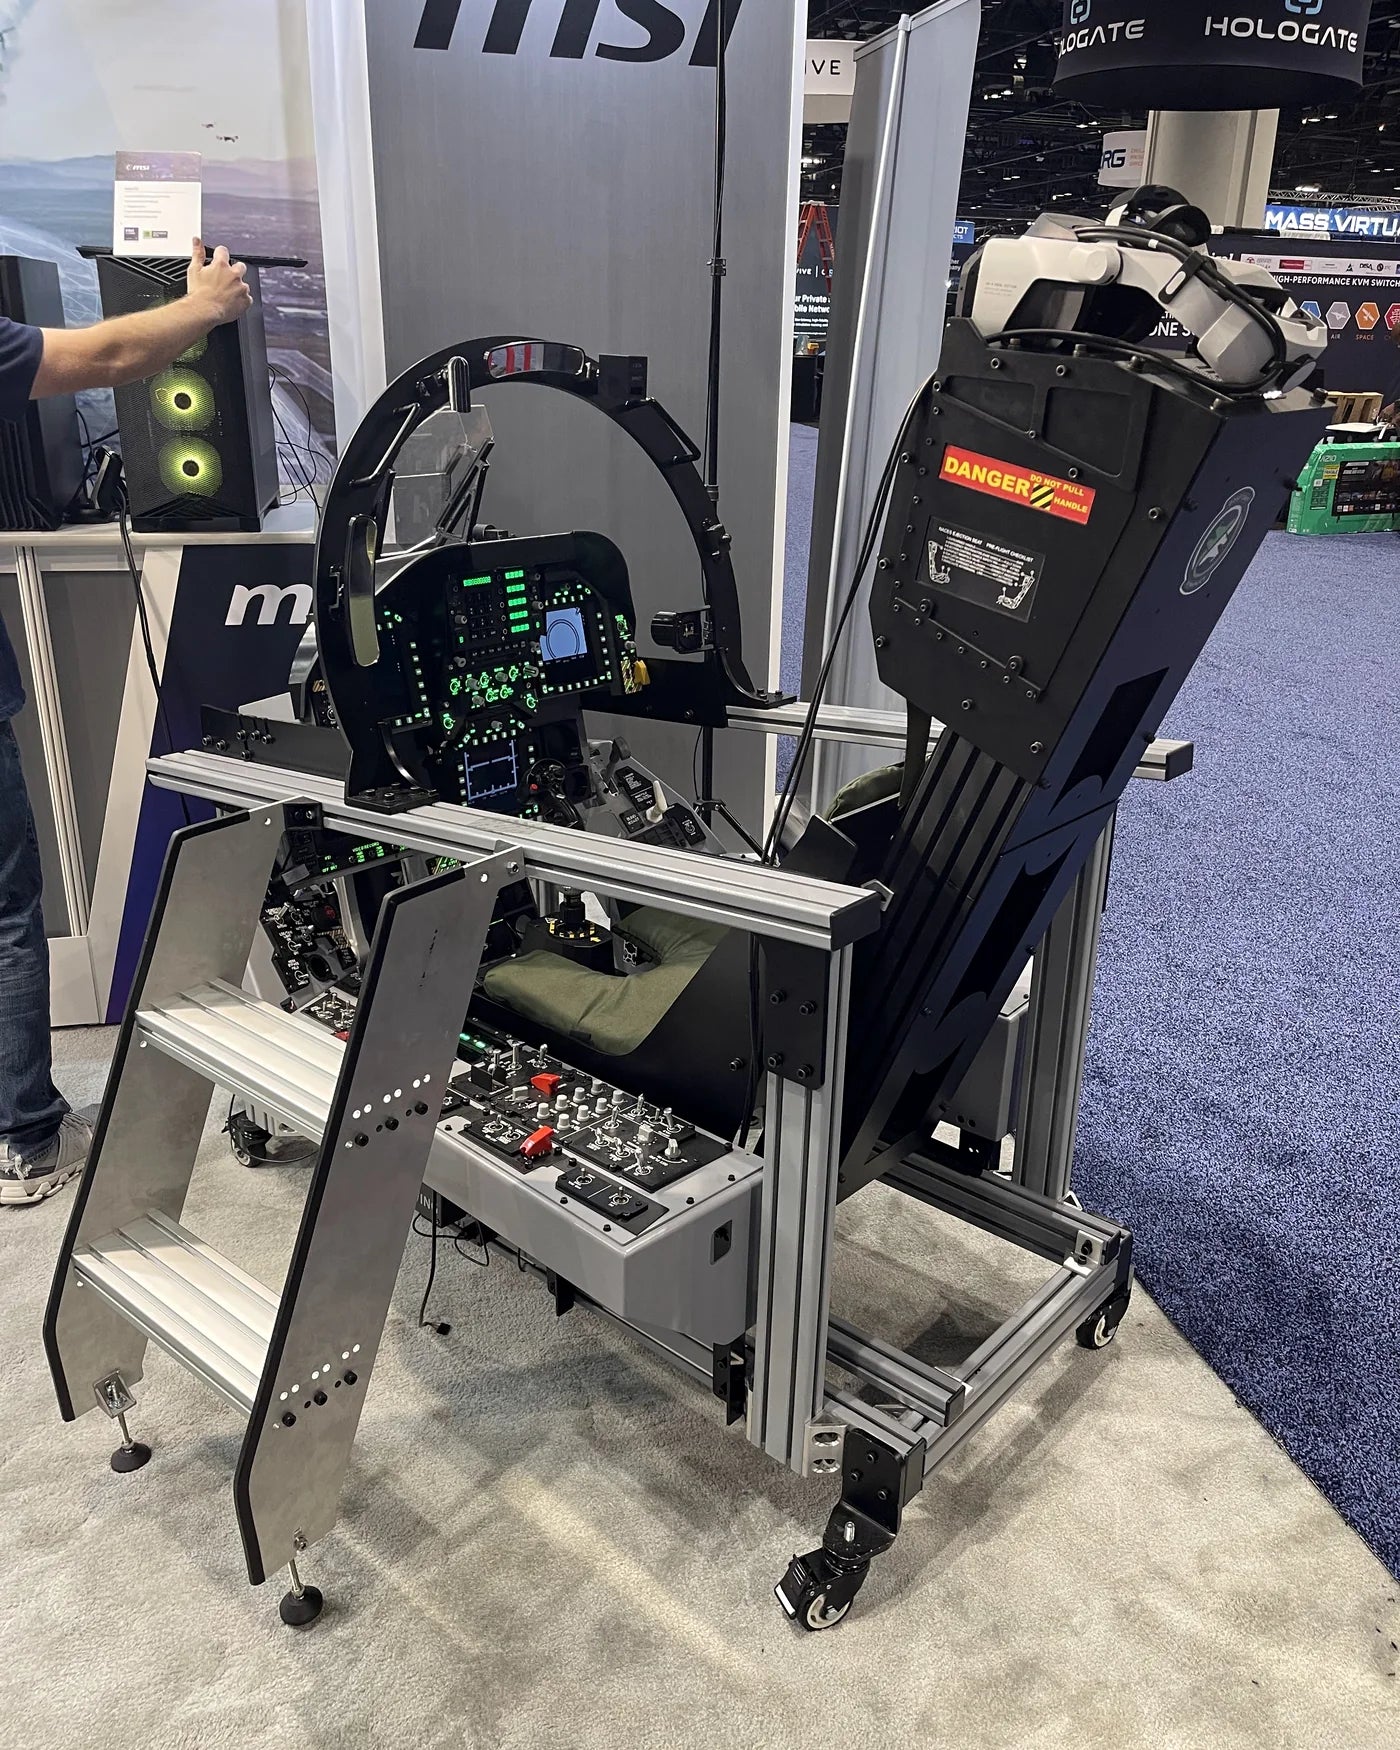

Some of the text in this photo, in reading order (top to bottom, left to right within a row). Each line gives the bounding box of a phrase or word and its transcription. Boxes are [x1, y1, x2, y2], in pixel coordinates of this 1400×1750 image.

[1204, 16, 1358, 53] HOLOGATE
[1265, 211, 1330, 231] MASS
[1273, 275, 1350, 286] IGH-PERFORMANCE
[1352, 278, 1370, 286] KVM
[802, 294, 827, 303] Private
[944, 456, 1031, 497] DANGER
[1030, 474, 1084, 496] DO NOT PULL
[1053, 496, 1088, 513] HANDLE
